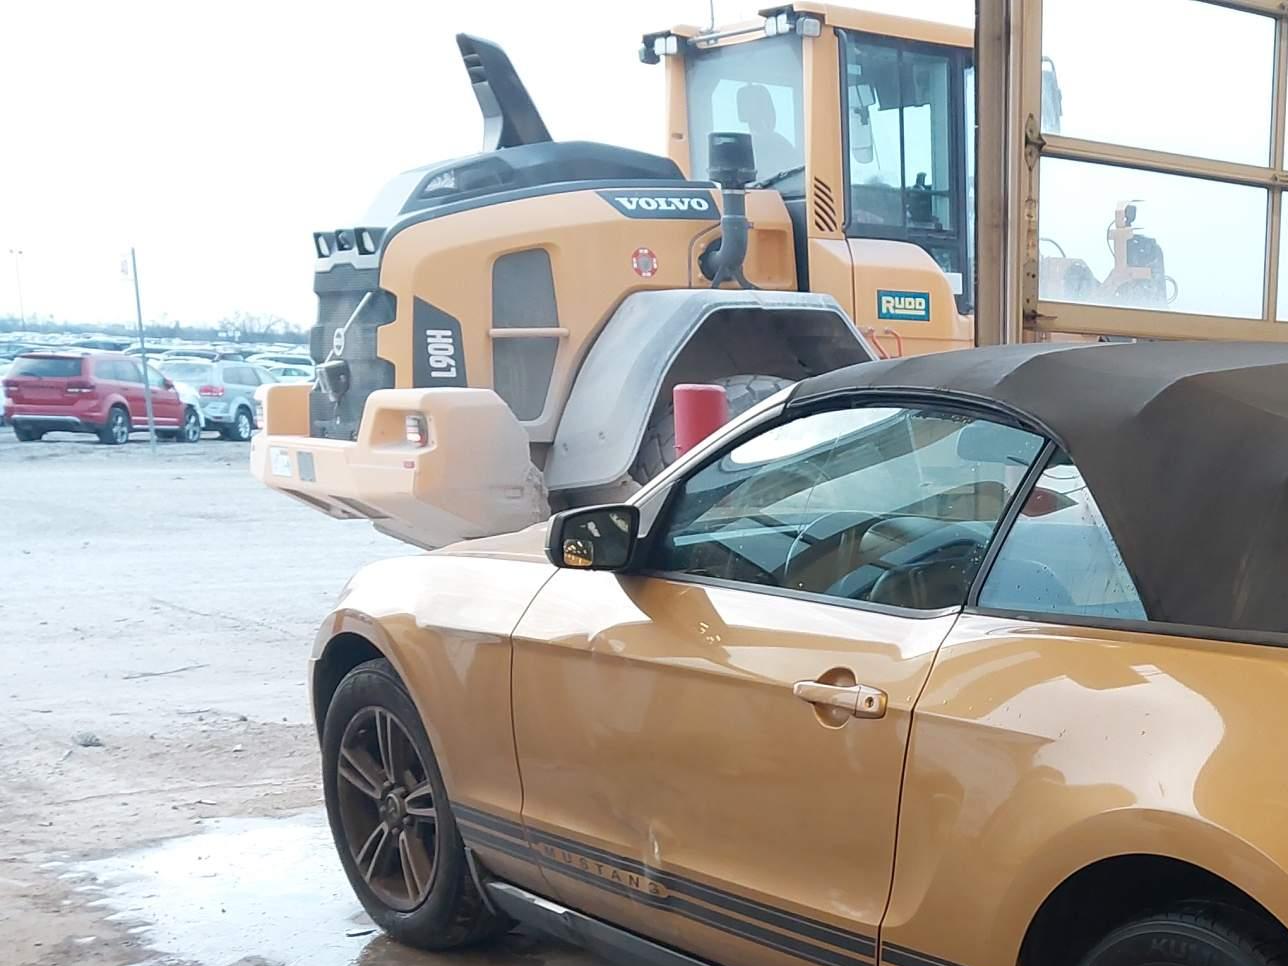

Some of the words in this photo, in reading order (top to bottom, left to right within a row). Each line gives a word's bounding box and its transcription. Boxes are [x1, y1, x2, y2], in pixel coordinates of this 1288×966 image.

[614, 197, 710, 211] VOLVO
[881, 295, 926, 314] RUDD
[426, 329, 457, 378] L90H
